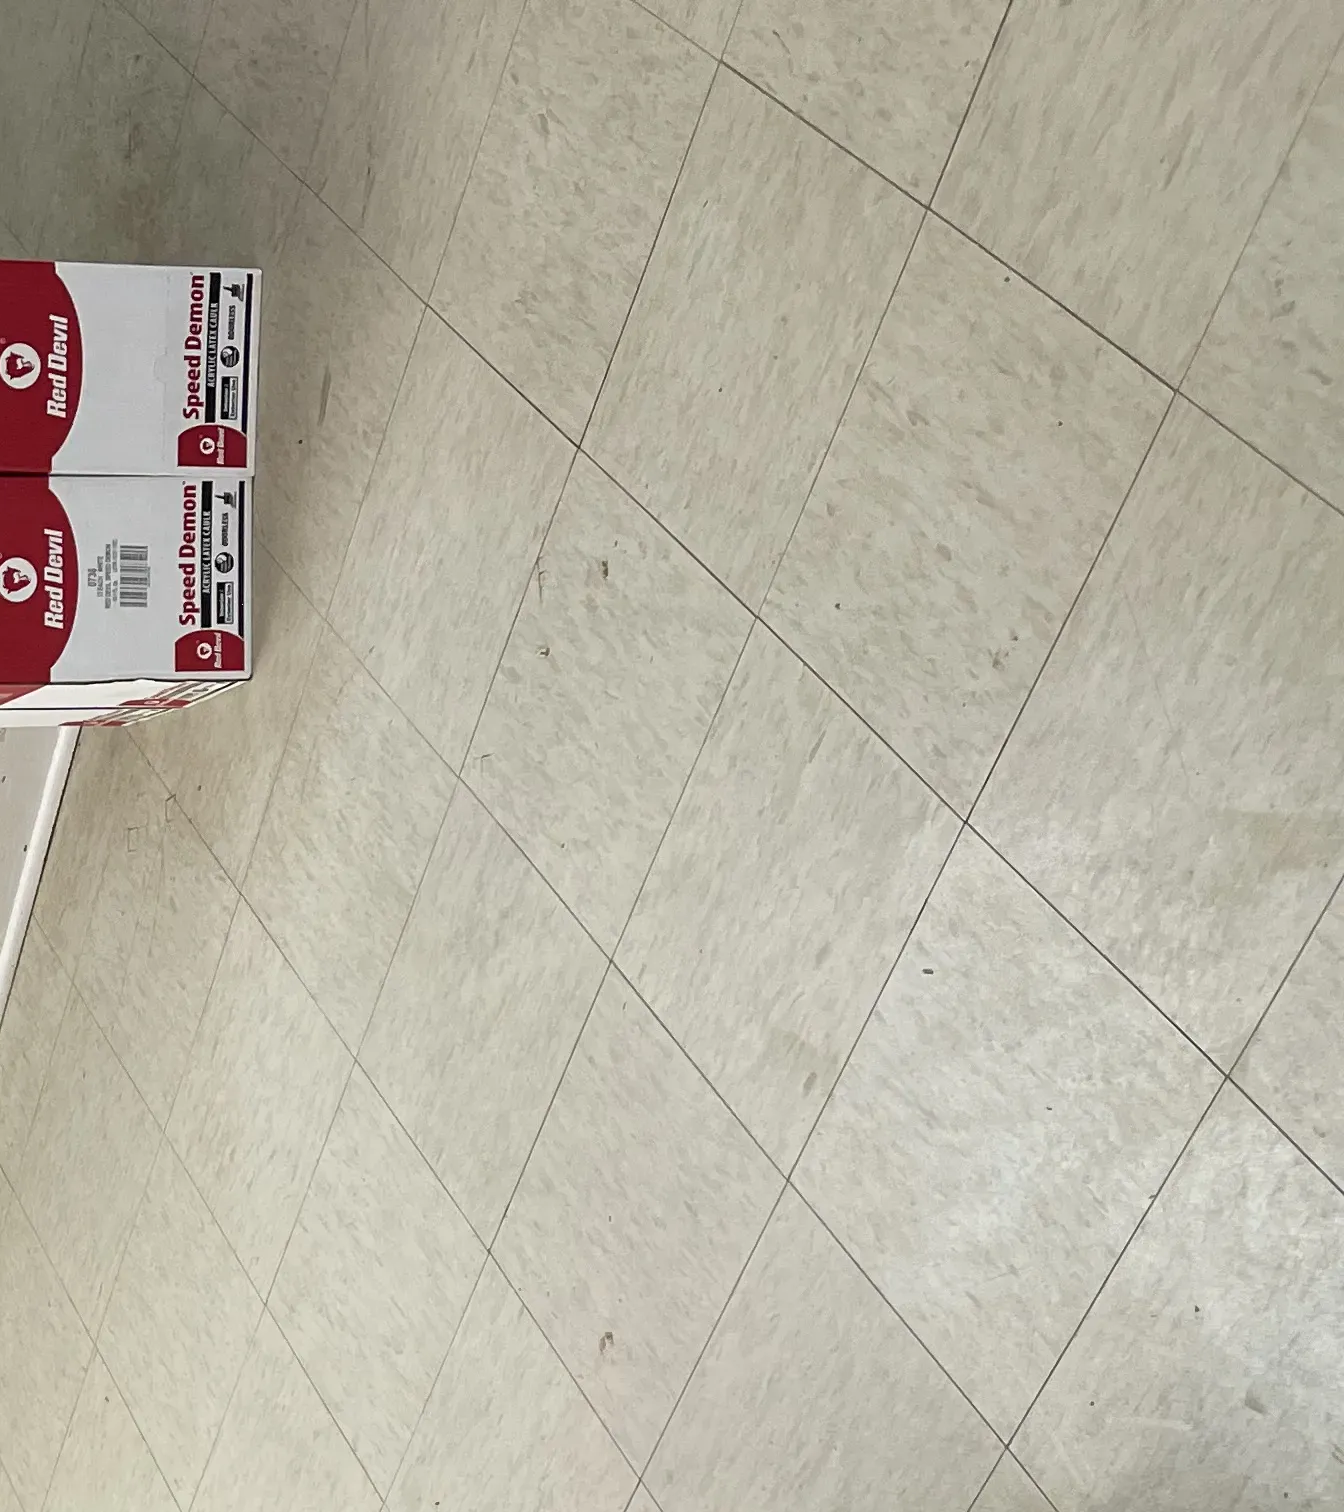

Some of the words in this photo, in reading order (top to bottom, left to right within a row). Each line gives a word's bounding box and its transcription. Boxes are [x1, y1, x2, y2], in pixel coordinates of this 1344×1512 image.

[185, 275, 204, 350] Demon
[209, 302, 218, 328] CAULK
[48, 314, 68, 371] Devil
[209, 330, 217, 353] LATEX
[183, 355, 204, 420] Speed
[207, 355, 216, 388] ACRYLIC
[47, 373, 67, 418] Red
[179, 485, 196, 557] Demon
[202, 511, 211, 535] CAULK
[44, 529, 63, 584] Devil
[202, 537, 211, 561] LATEX
[178, 564, 200, 625] Speed
[202, 563, 211, 594] ACRYLIC
[44, 586, 63, 629] Red
